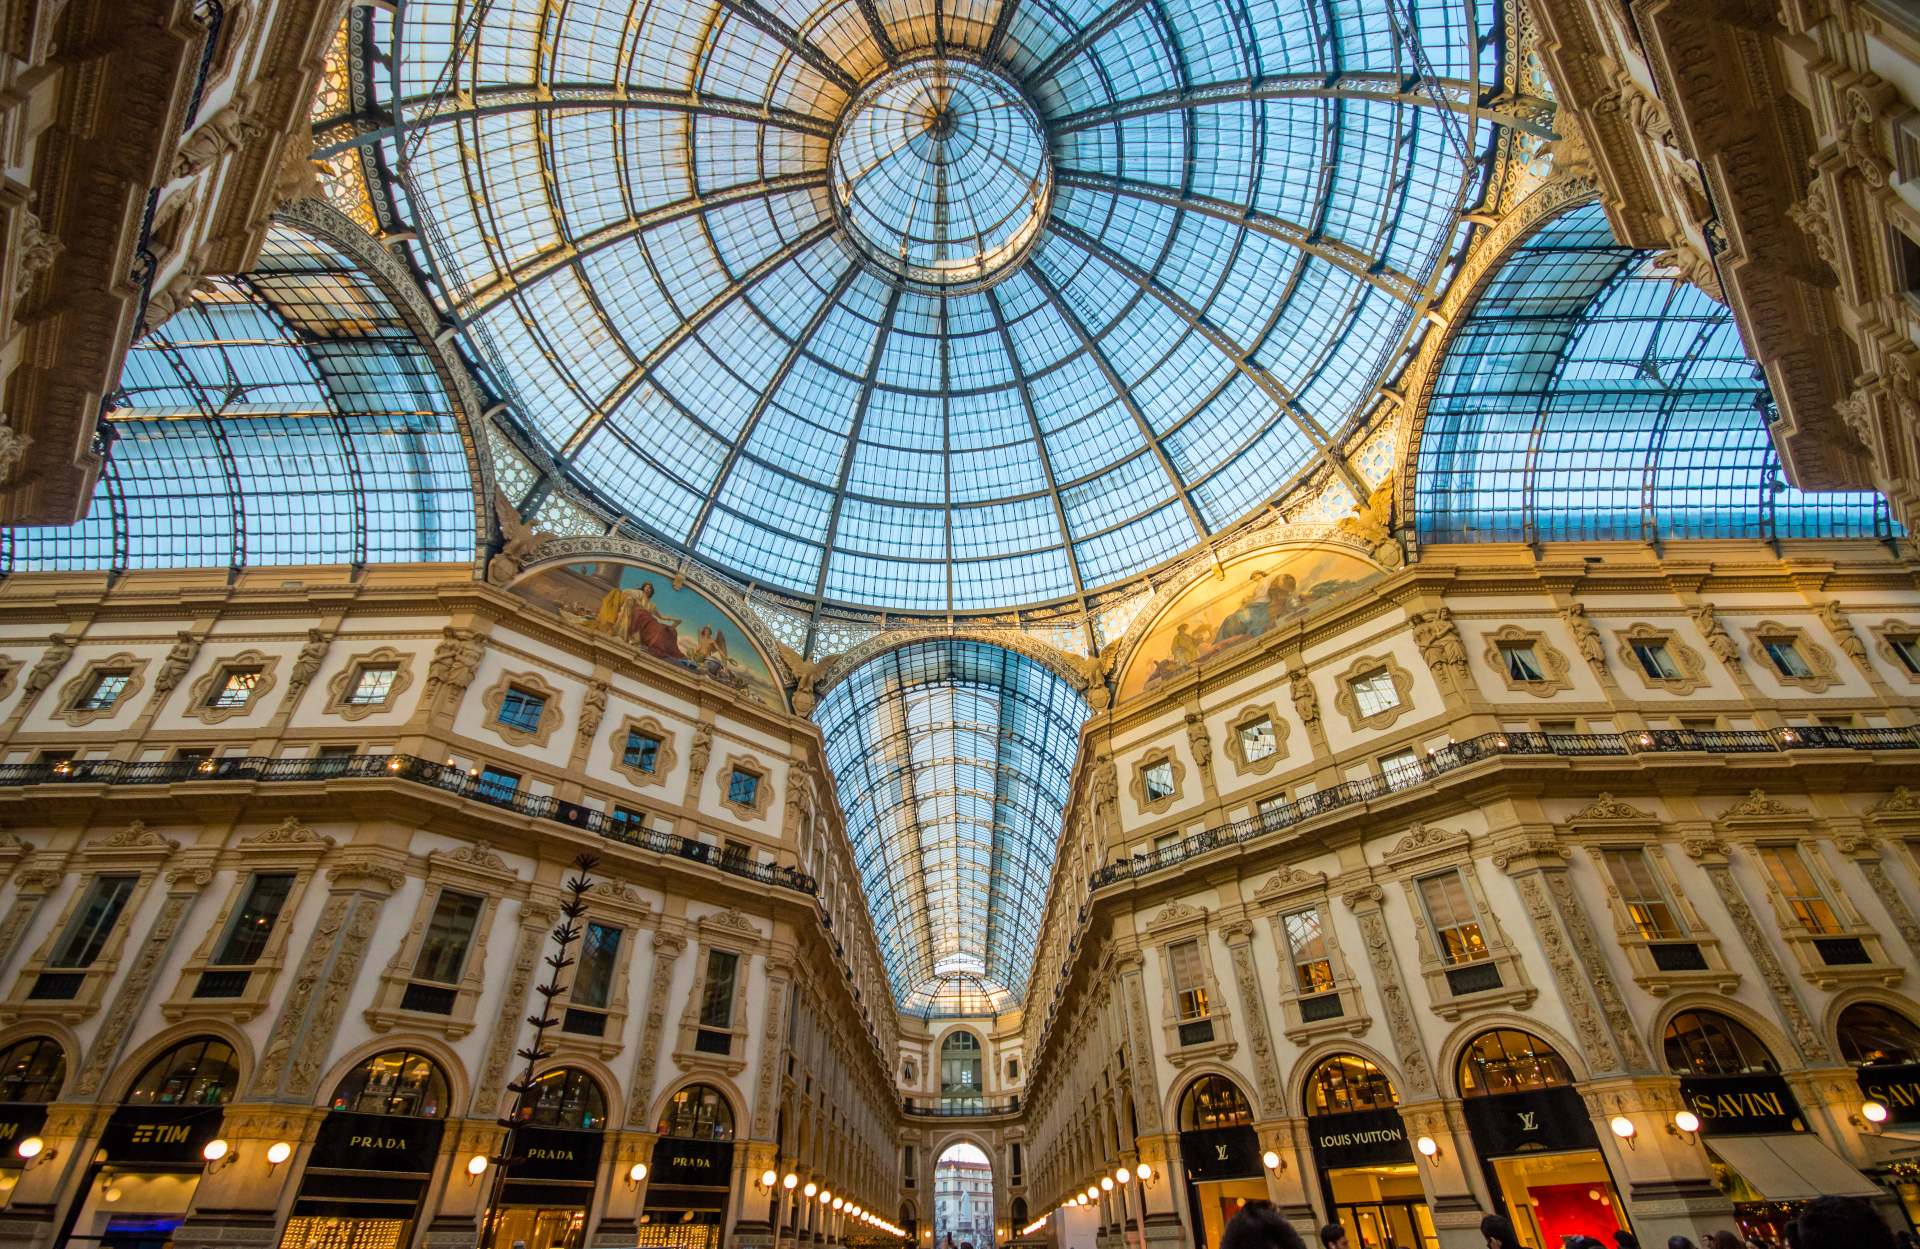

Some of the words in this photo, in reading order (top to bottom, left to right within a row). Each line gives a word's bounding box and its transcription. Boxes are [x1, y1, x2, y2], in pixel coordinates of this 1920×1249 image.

[1696, 1092, 1785, 1118] SAVINI
[155, 1125, 191, 1143] TIM
[1320, 1134, 1351, 1147] LOUIS
[1352, 1129, 1401, 1144] VUITTON
[350, 1136, 406, 1150] PRADA
[528, 1148, 574, 1160] PRADA
[672, 1157, 710, 1168] PRADA
